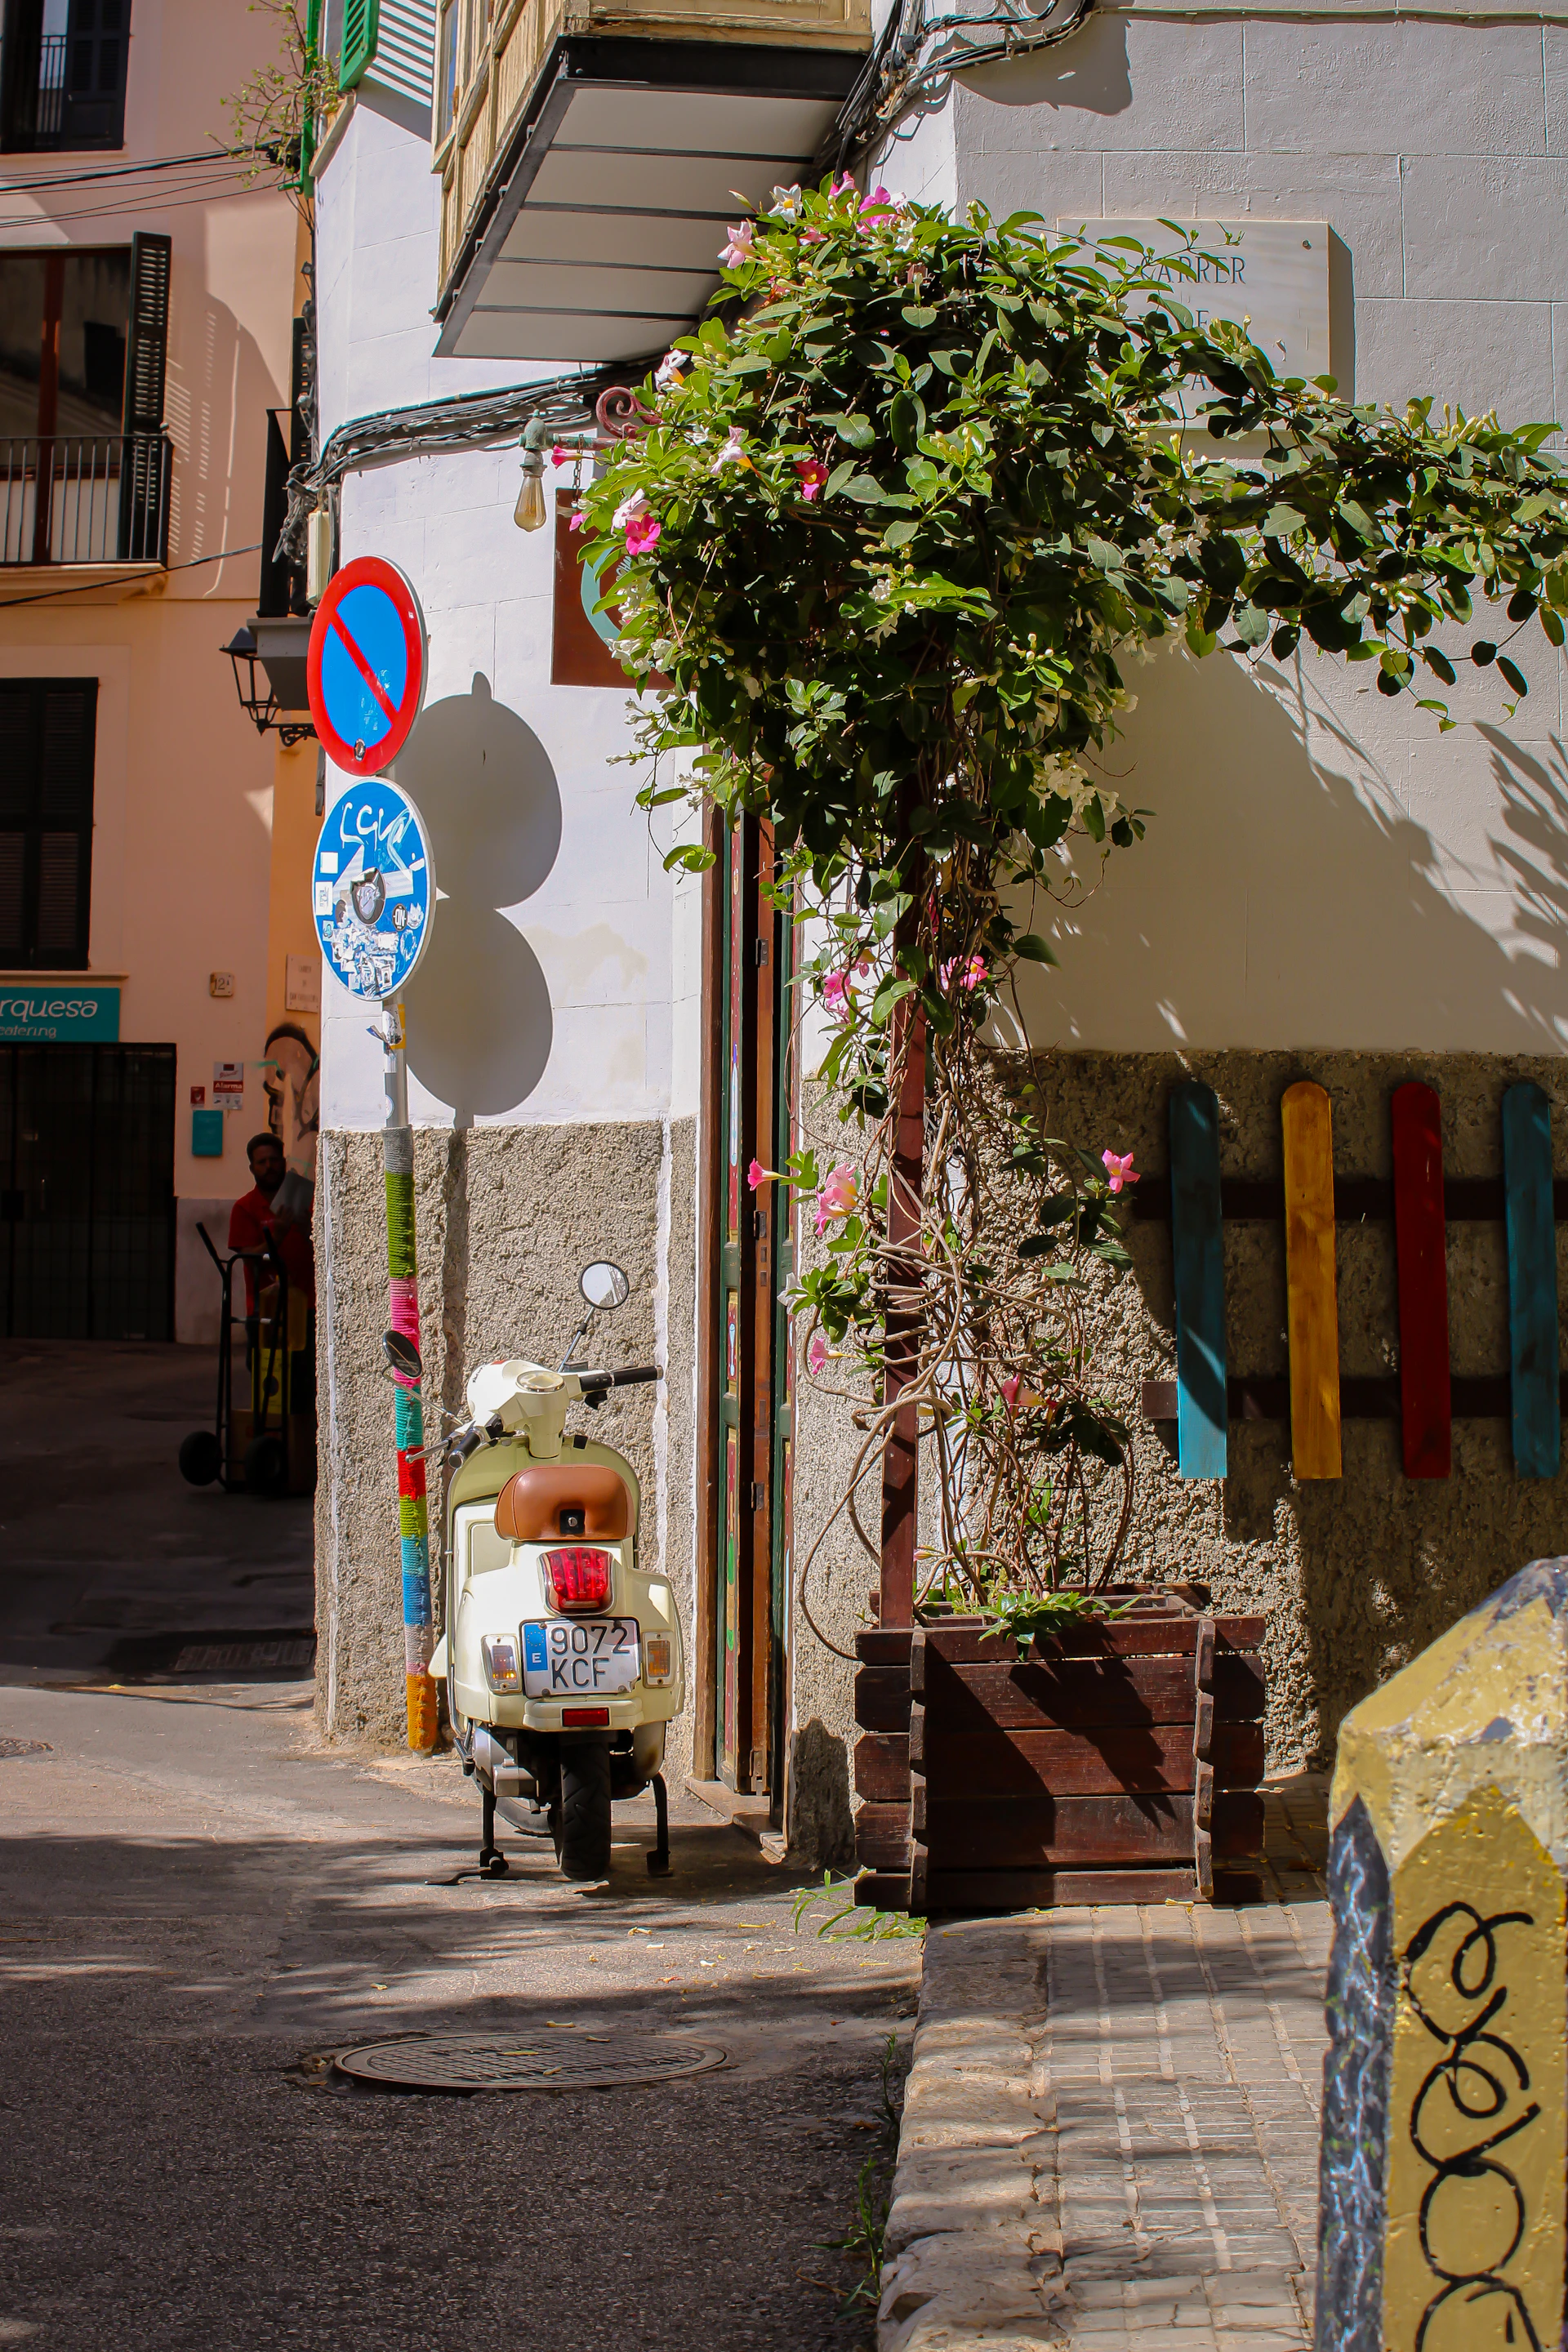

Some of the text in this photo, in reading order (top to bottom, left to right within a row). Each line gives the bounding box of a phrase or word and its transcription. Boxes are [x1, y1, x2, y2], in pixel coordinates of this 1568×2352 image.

[1141, 256, 1246, 284] CARRER
[550, 1625, 630, 1655] 9072
[532, 1652, 541, 1664] E
[551, 1657, 610, 1688] KCF
